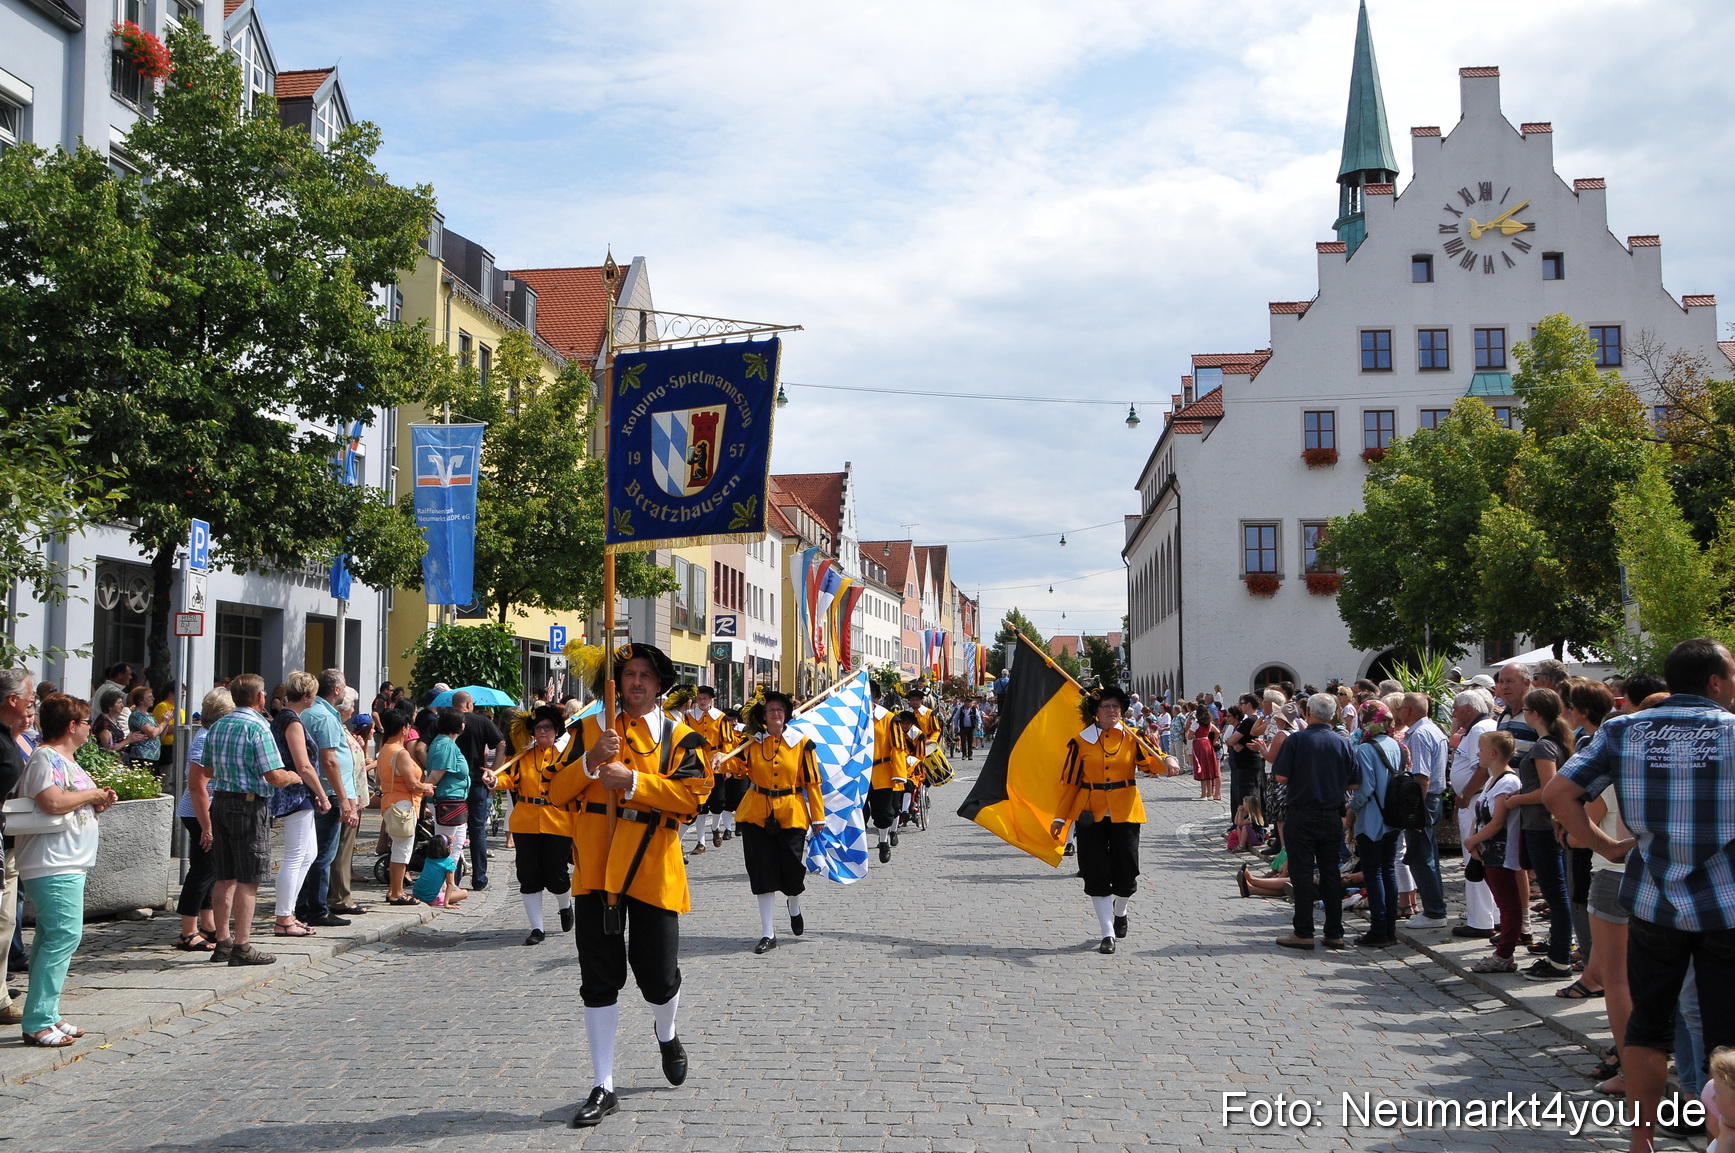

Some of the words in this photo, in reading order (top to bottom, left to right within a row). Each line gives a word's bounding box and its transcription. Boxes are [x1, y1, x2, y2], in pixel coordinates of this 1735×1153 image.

[621, 371, 753, 436] Kolping-Spielmannszug
[628, 451, 641, 465] 19
[729, 443, 745, 458] 57
[624, 474, 741, 522] Beratzhausen
[195, 526, 205, 562] P
[554, 629, 563, 649] P
[1630, 721, 1728, 742] Saltwater
